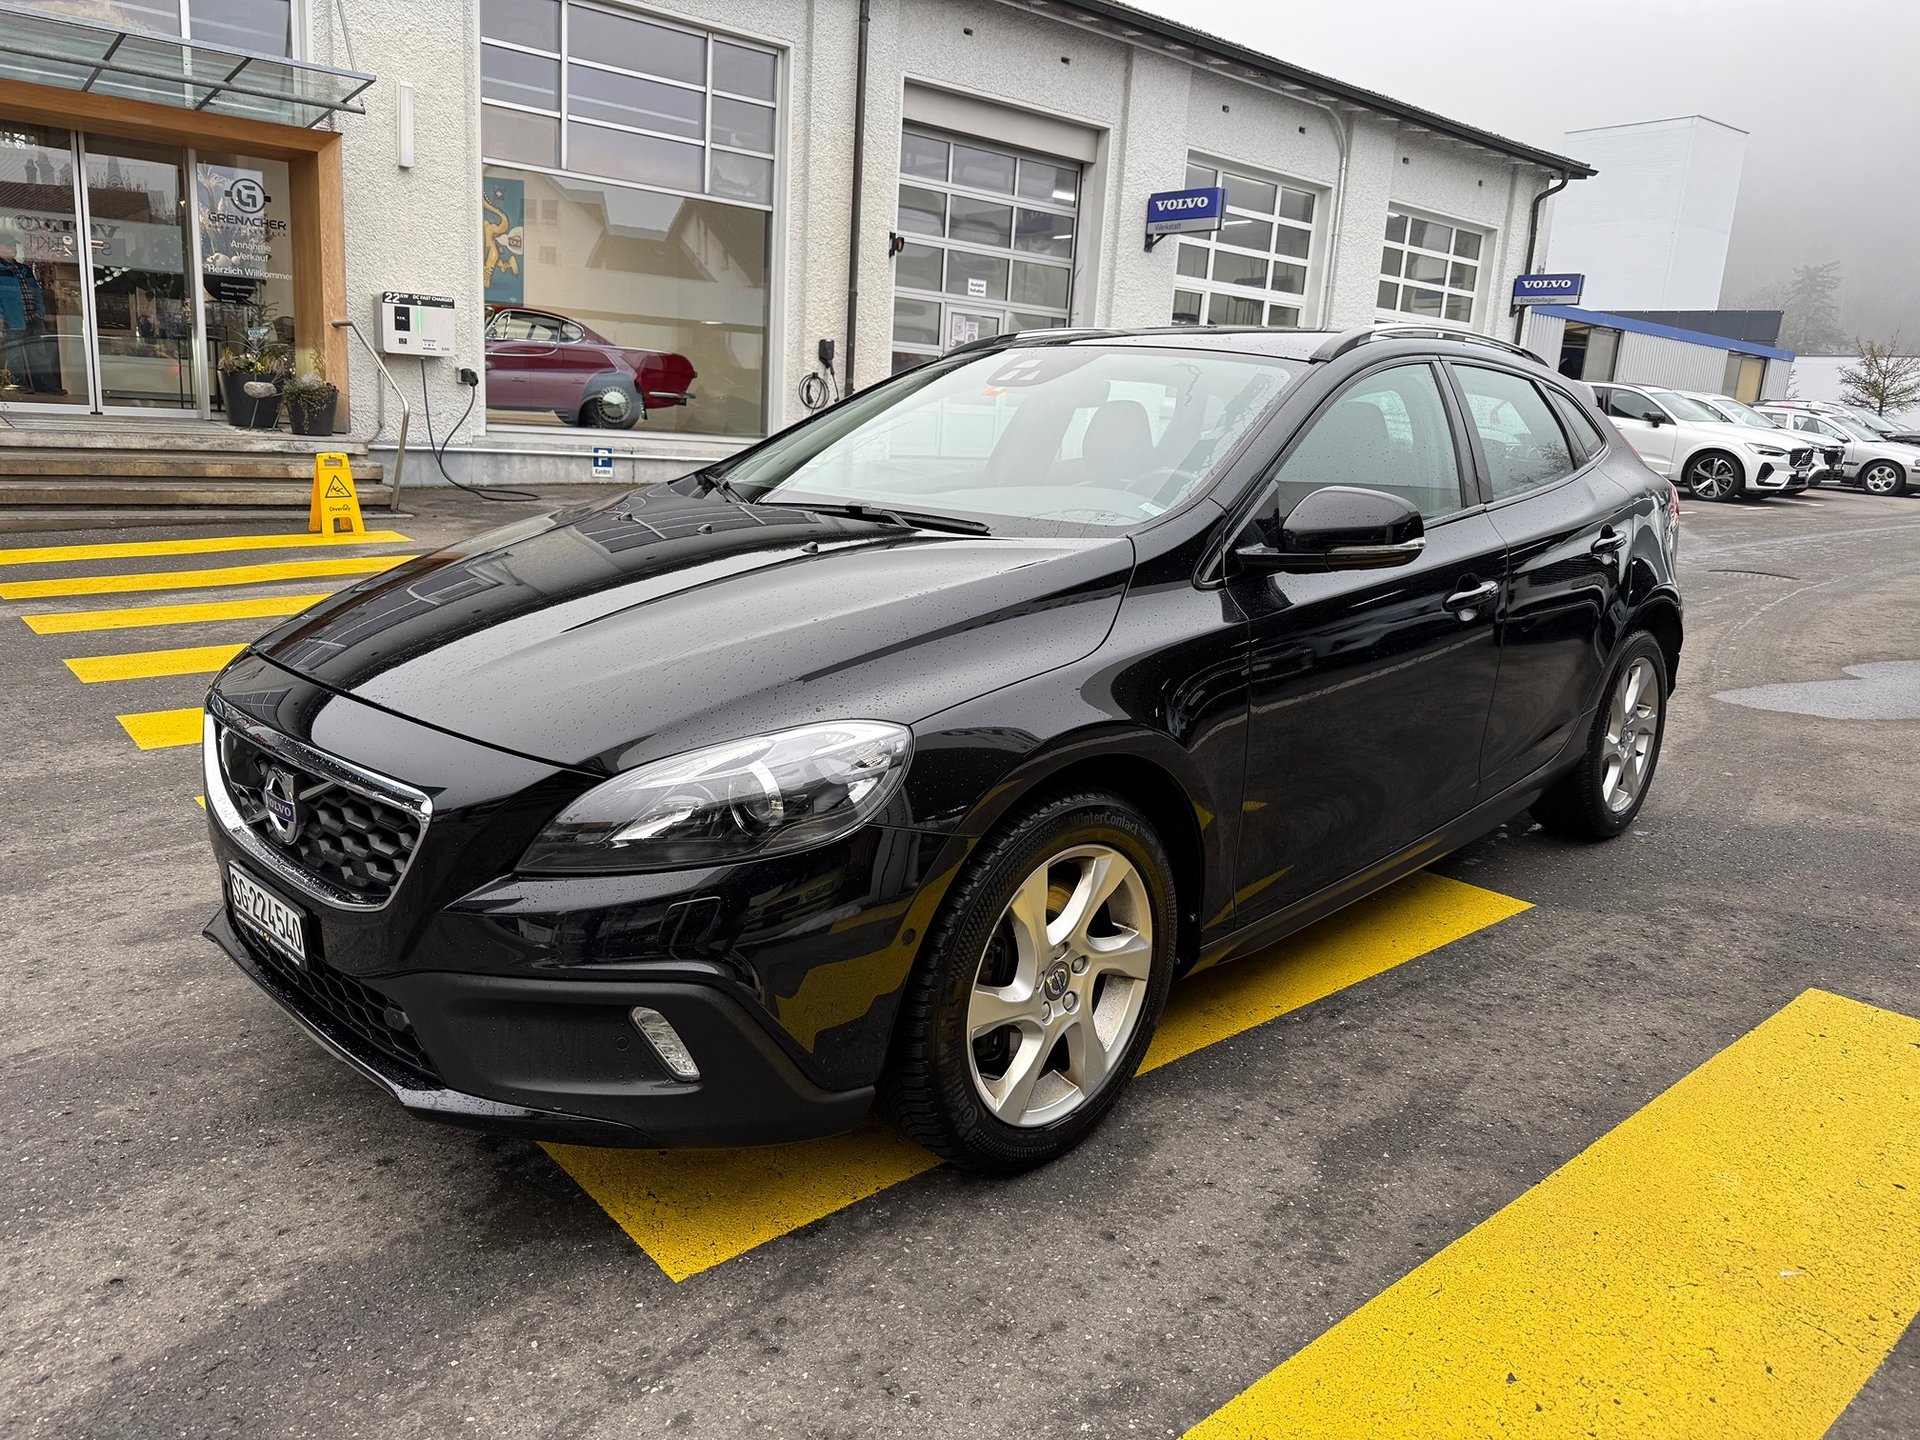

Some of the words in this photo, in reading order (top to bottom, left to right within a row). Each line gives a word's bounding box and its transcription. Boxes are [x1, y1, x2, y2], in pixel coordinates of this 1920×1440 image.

[1155, 196, 1209, 212] VOLVO
[208, 212, 287, 231] GRENACHER
[1154, 223, 1182, 232] Werkstatt
[230, 240, 272, 252] Annahme
[236, 250, 269, 262] Verkauf
[208, 263, 243, 275] Herzlich
[1522, 279, 1572, 289] VOLVO
[384, 292, 400, 304] 22
